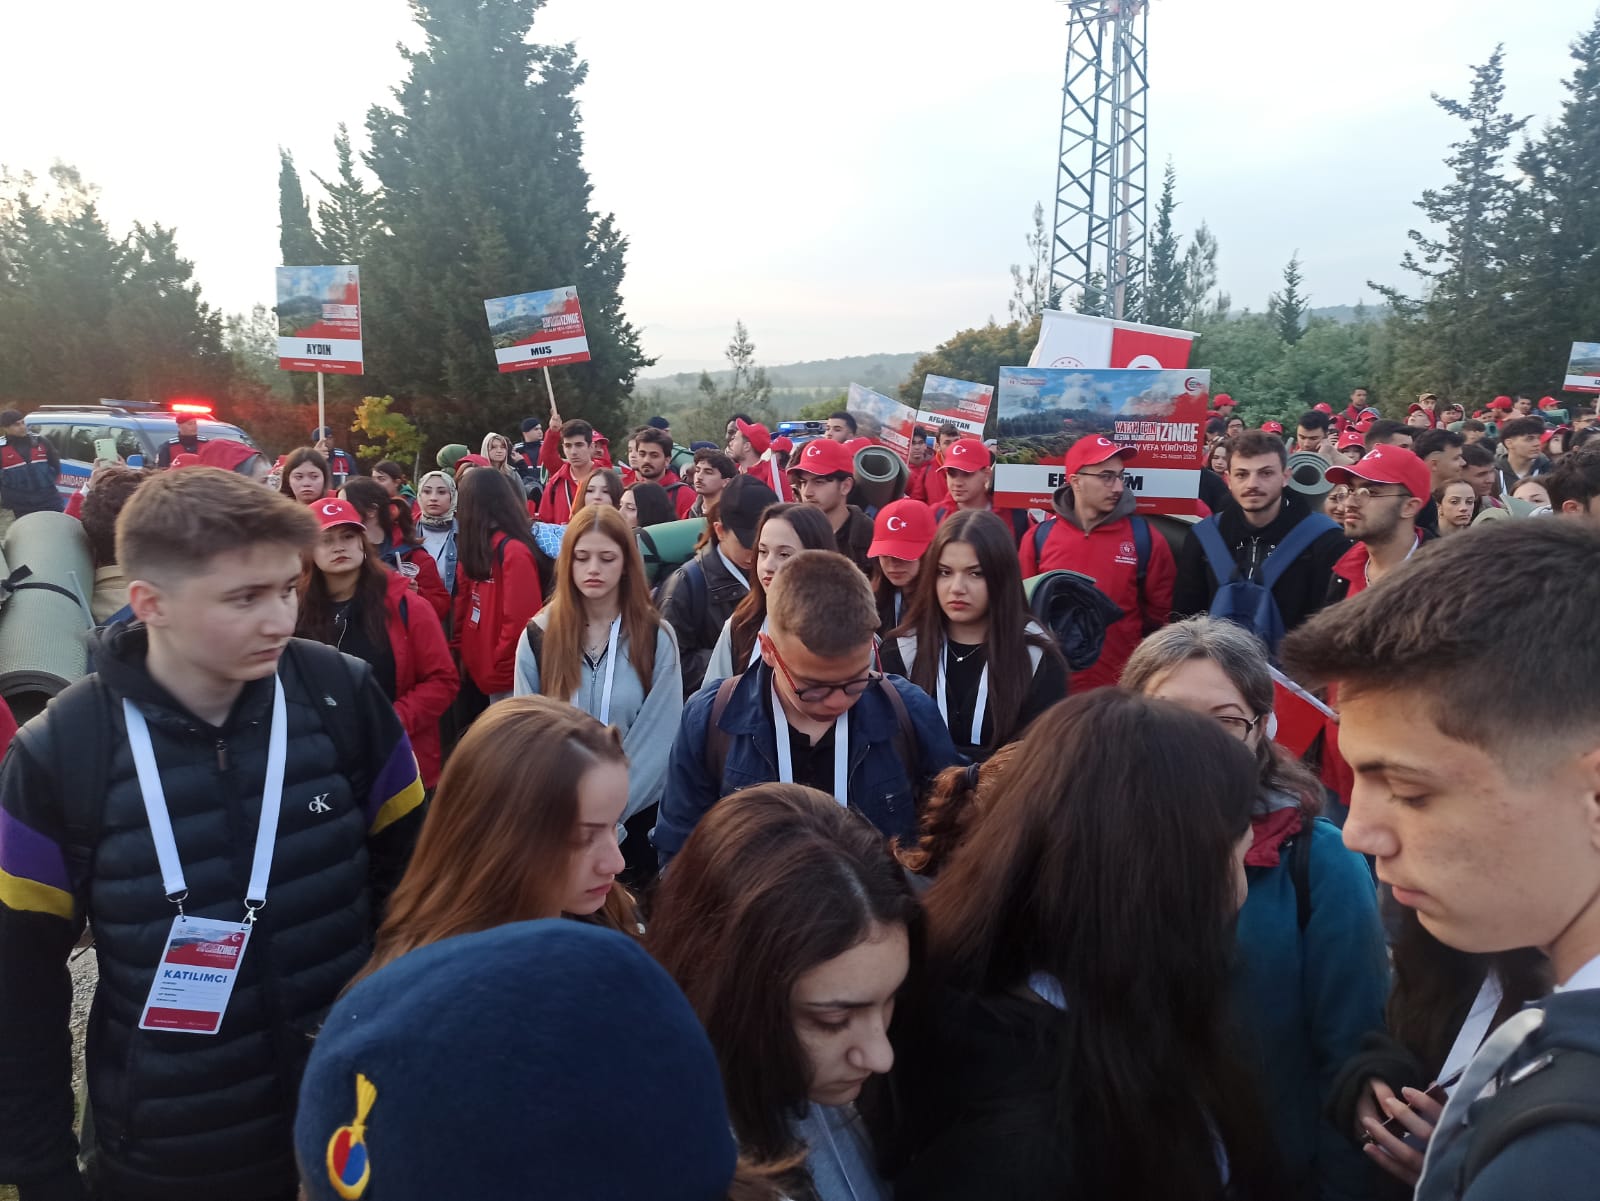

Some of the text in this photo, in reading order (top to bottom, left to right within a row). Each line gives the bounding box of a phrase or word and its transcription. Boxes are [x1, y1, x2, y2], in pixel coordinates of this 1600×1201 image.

[306, 343, 332, 356] AYDIN
[530, 345, 552, 356] MUŞ
[1115, 421, 1139, 434] VATAN
[1157, 422, 1199, 442] İZİNDE
[1142, 443, 1160, 451] VEFA
[1160, 443, 1198, 453] YÜRÜYÜŞÜ
[163, 968, 228, 984] KATILIMCI
